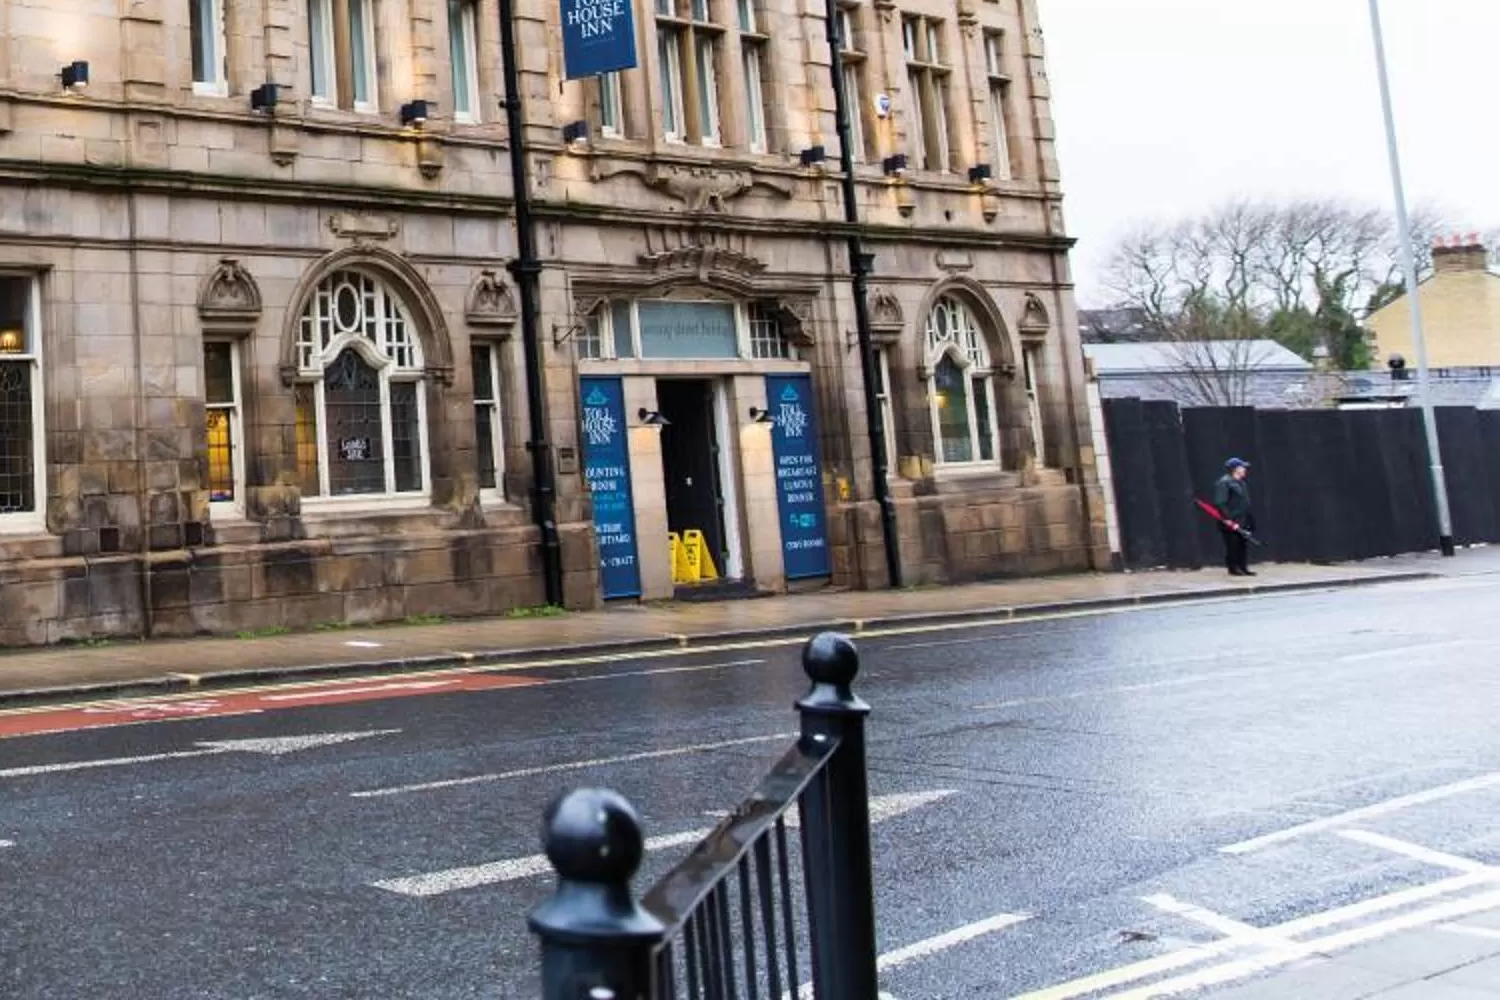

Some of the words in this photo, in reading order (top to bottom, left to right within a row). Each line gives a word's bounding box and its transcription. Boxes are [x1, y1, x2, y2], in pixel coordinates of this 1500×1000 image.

[567, 0, 625, 25] HOUSE
[581, 18, 613, 39] INN
[583, 408, 613, 421] TOLL
[780, 403, 802, 417] TOLL
[582, 416, 618, 434] HOUSE
[589, 430, 611, 446] INN
